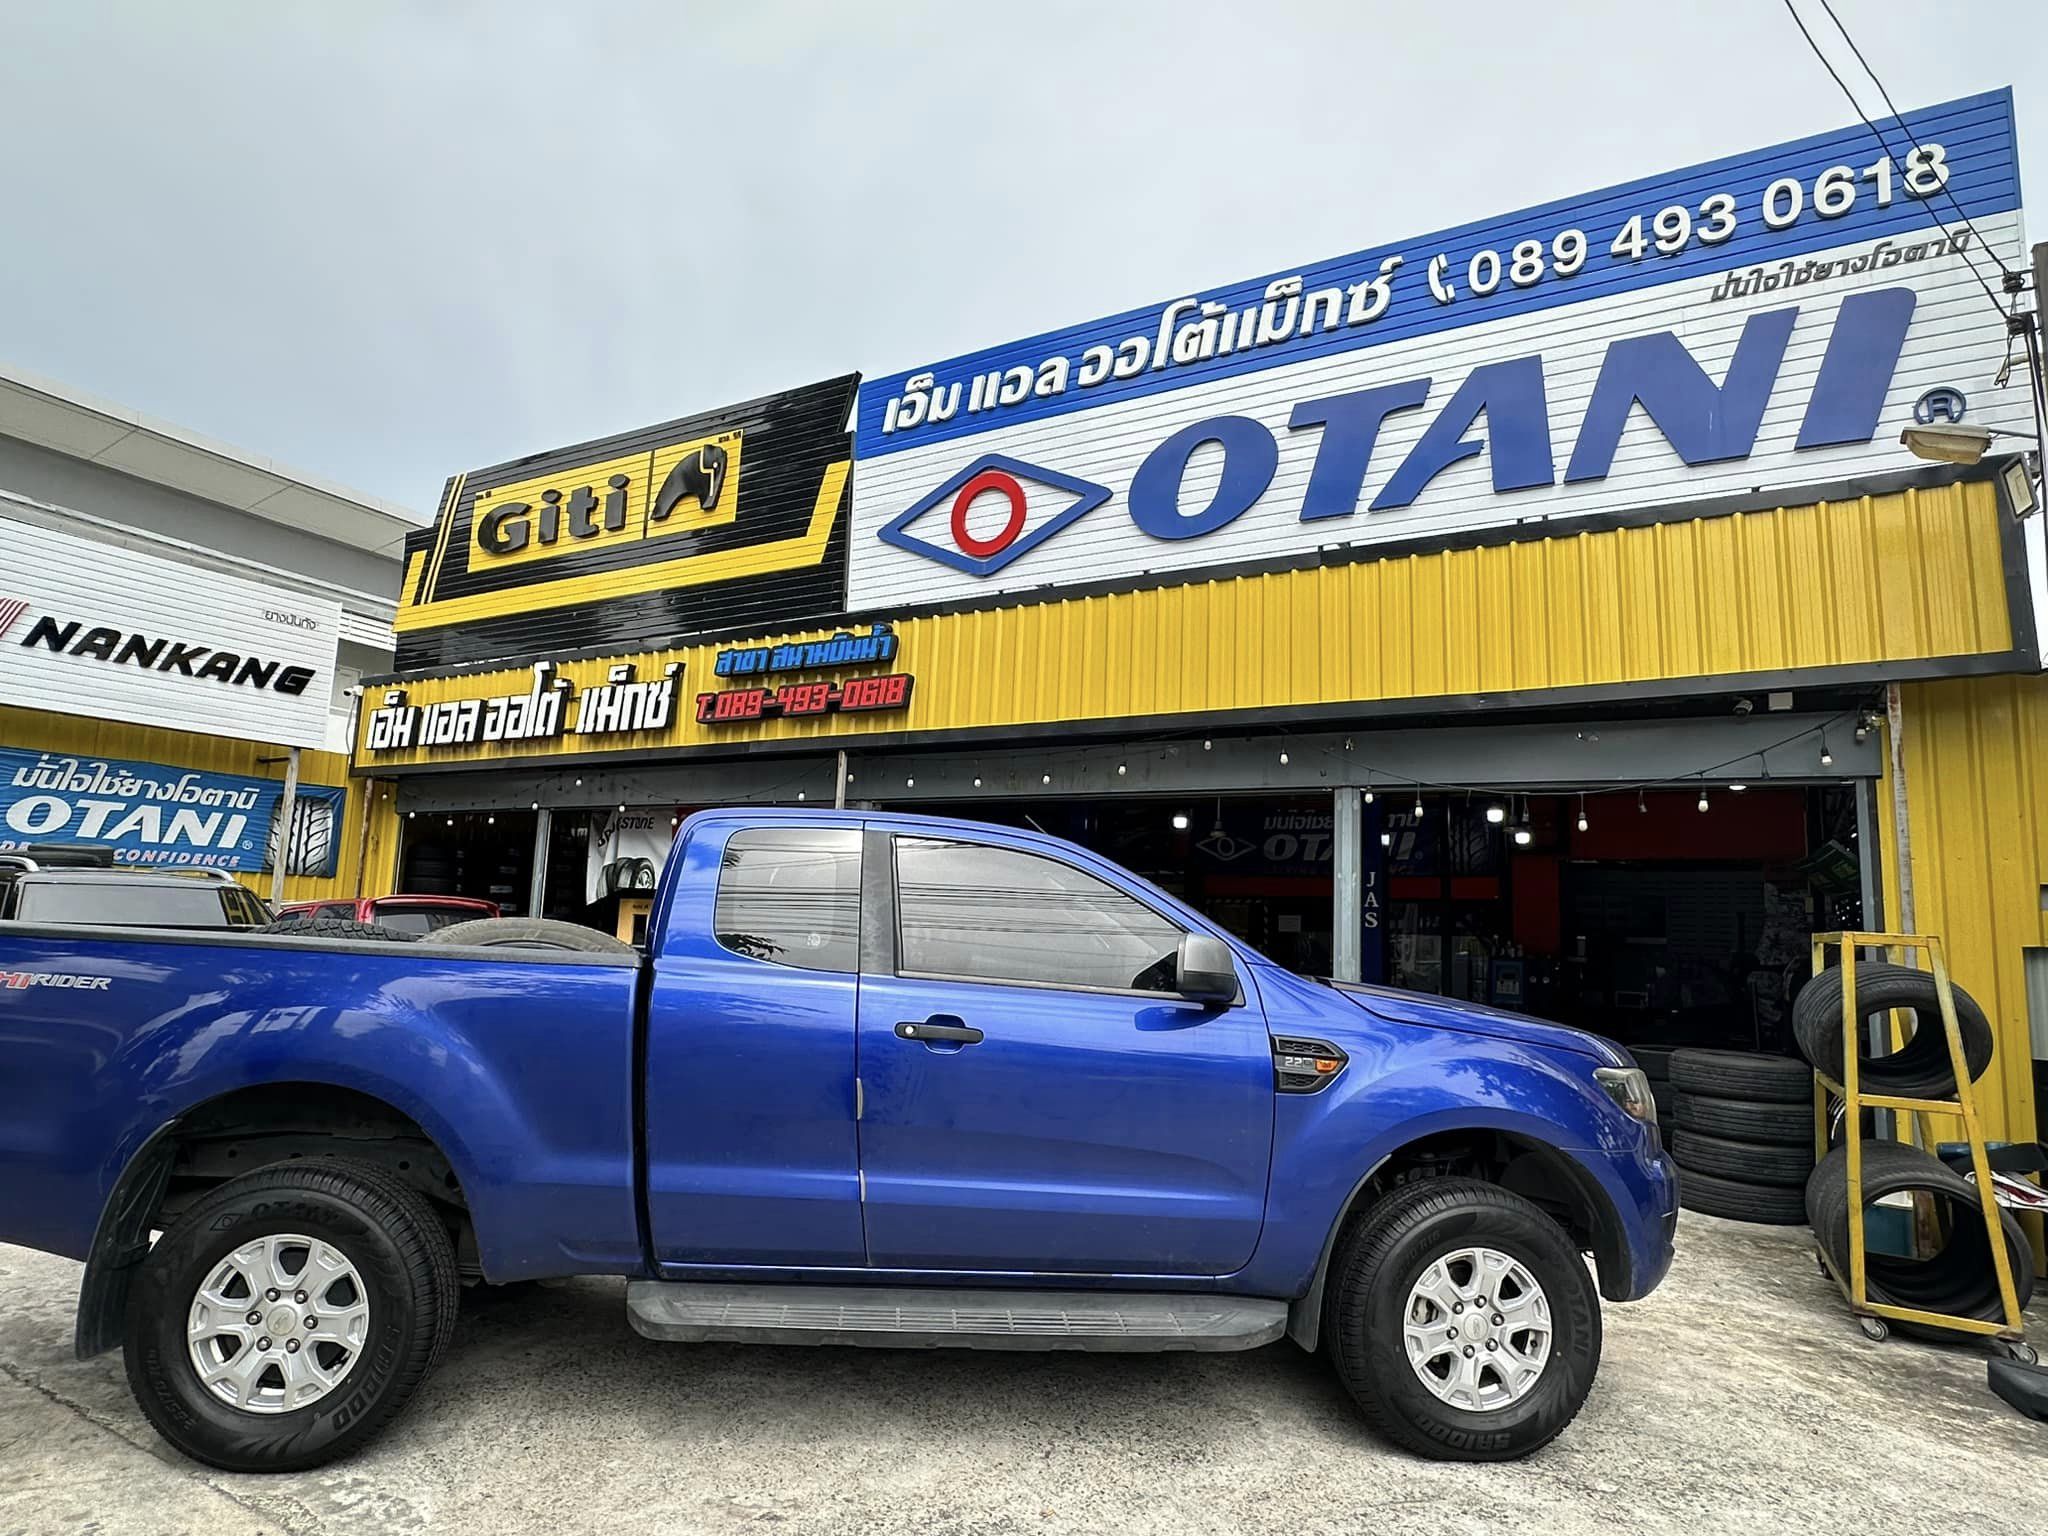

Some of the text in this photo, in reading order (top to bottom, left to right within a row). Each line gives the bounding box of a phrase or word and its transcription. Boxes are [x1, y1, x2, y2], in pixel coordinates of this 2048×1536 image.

[1468, 142, 1951, 296] 089 493 0618
[882, 372, 960, 433] เอ็ม
[967, 356, 1069, 414] แอล
[1128, 287, 1917, 540] OTANI
[477, 473, 631, 555] Giti
[21, 616, 316, 696] NANKANG
[716, 651, 768, 674] สาขา
[365, 690, 417, 750] เอ็ม
[417, 699, 484, 746] แอล
[11, 754, 260, 810] มั่นใจใช้ยางโอตานิ
[6, 796, 248, 850] OTANI
[113, 848, 241, 868] CONFIDENCE
